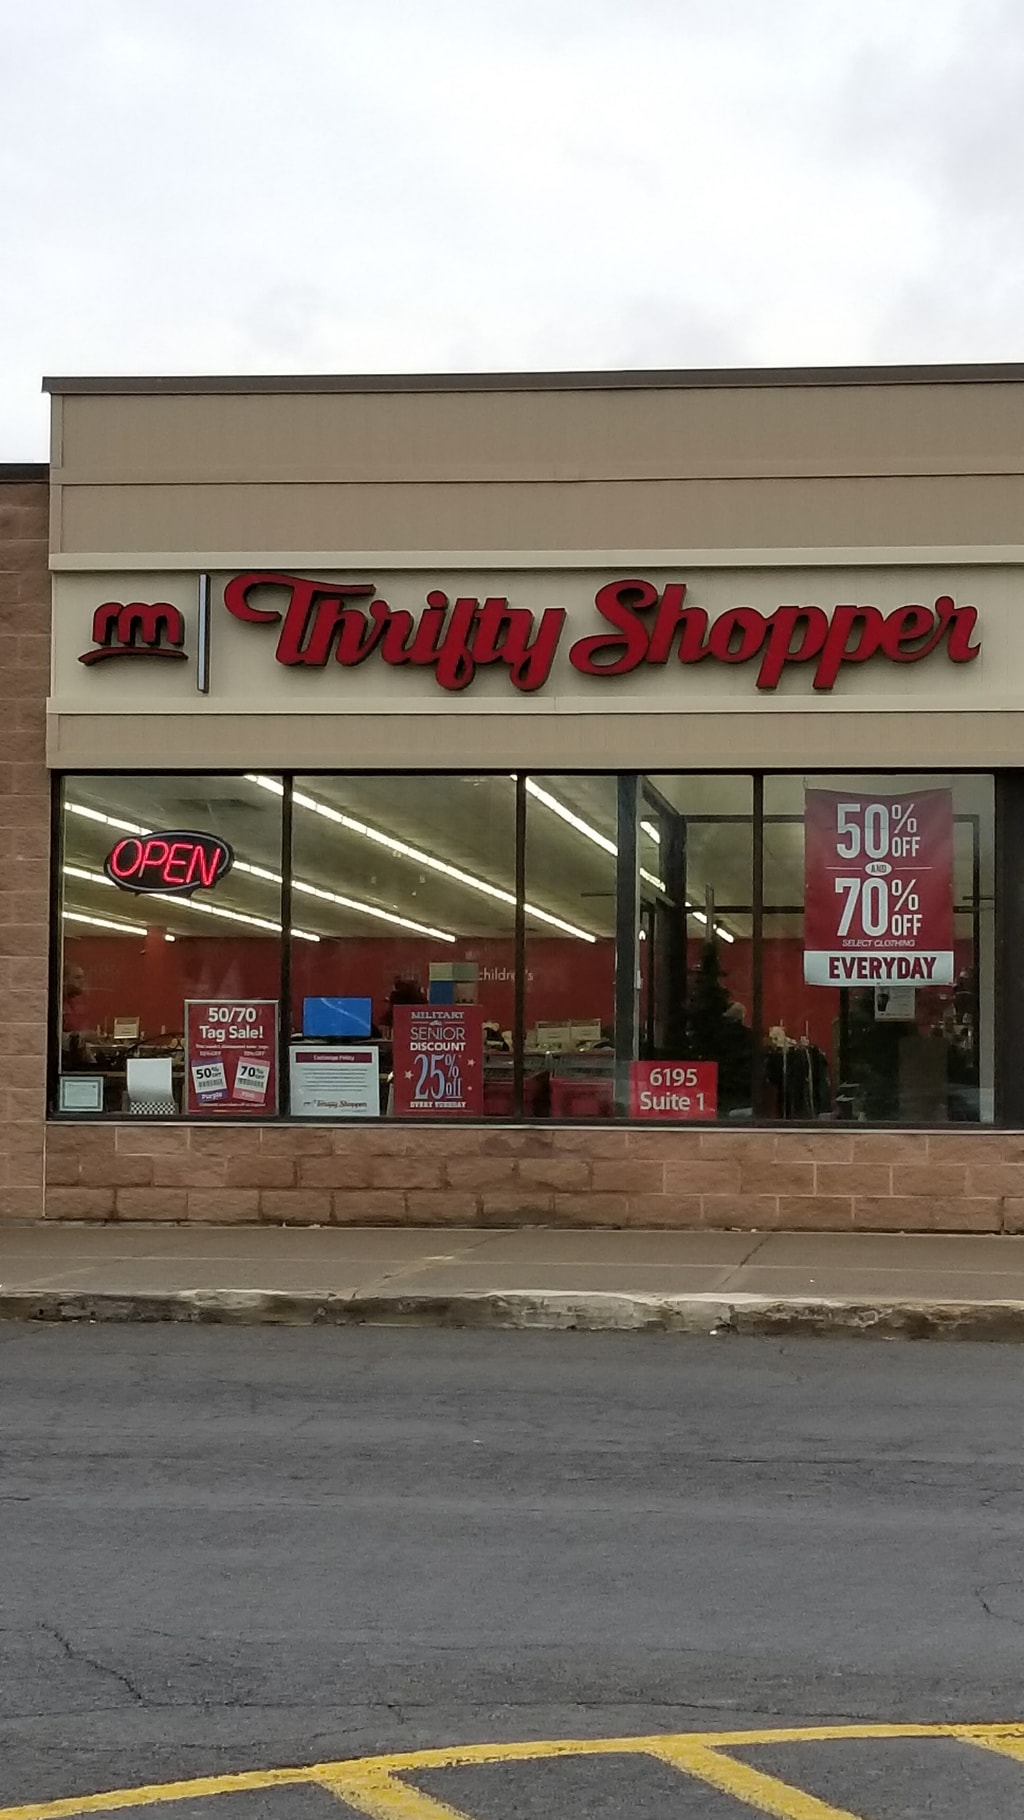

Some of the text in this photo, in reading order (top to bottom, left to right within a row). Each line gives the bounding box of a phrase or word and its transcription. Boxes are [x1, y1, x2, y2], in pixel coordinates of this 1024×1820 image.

[223, 572, 981, 692] Thrifty Shopper
[891, 837, 921, 857] OFF
[111, 838, 221, 885] OPEN
[870, 864, 887, 873] AND
[891, 914, 923, 936] OFF
[842, 938, 916, 948] SELECT CLOTHING
[829, 957, 937, 979] EVERYDAY
[208, 1007, 257, 1023] 50/70
[199, 1025, 264, 1042] Tag Sale!
[410, 1027, 465, 1040] SENIOR
[410, 1042, 466, 1051] DISCOUNT
[446, 1077, 462, 1096] off
[650, 1068, 698, 1087] 6195
[640, 1091, 704, 1111] Suite 1
